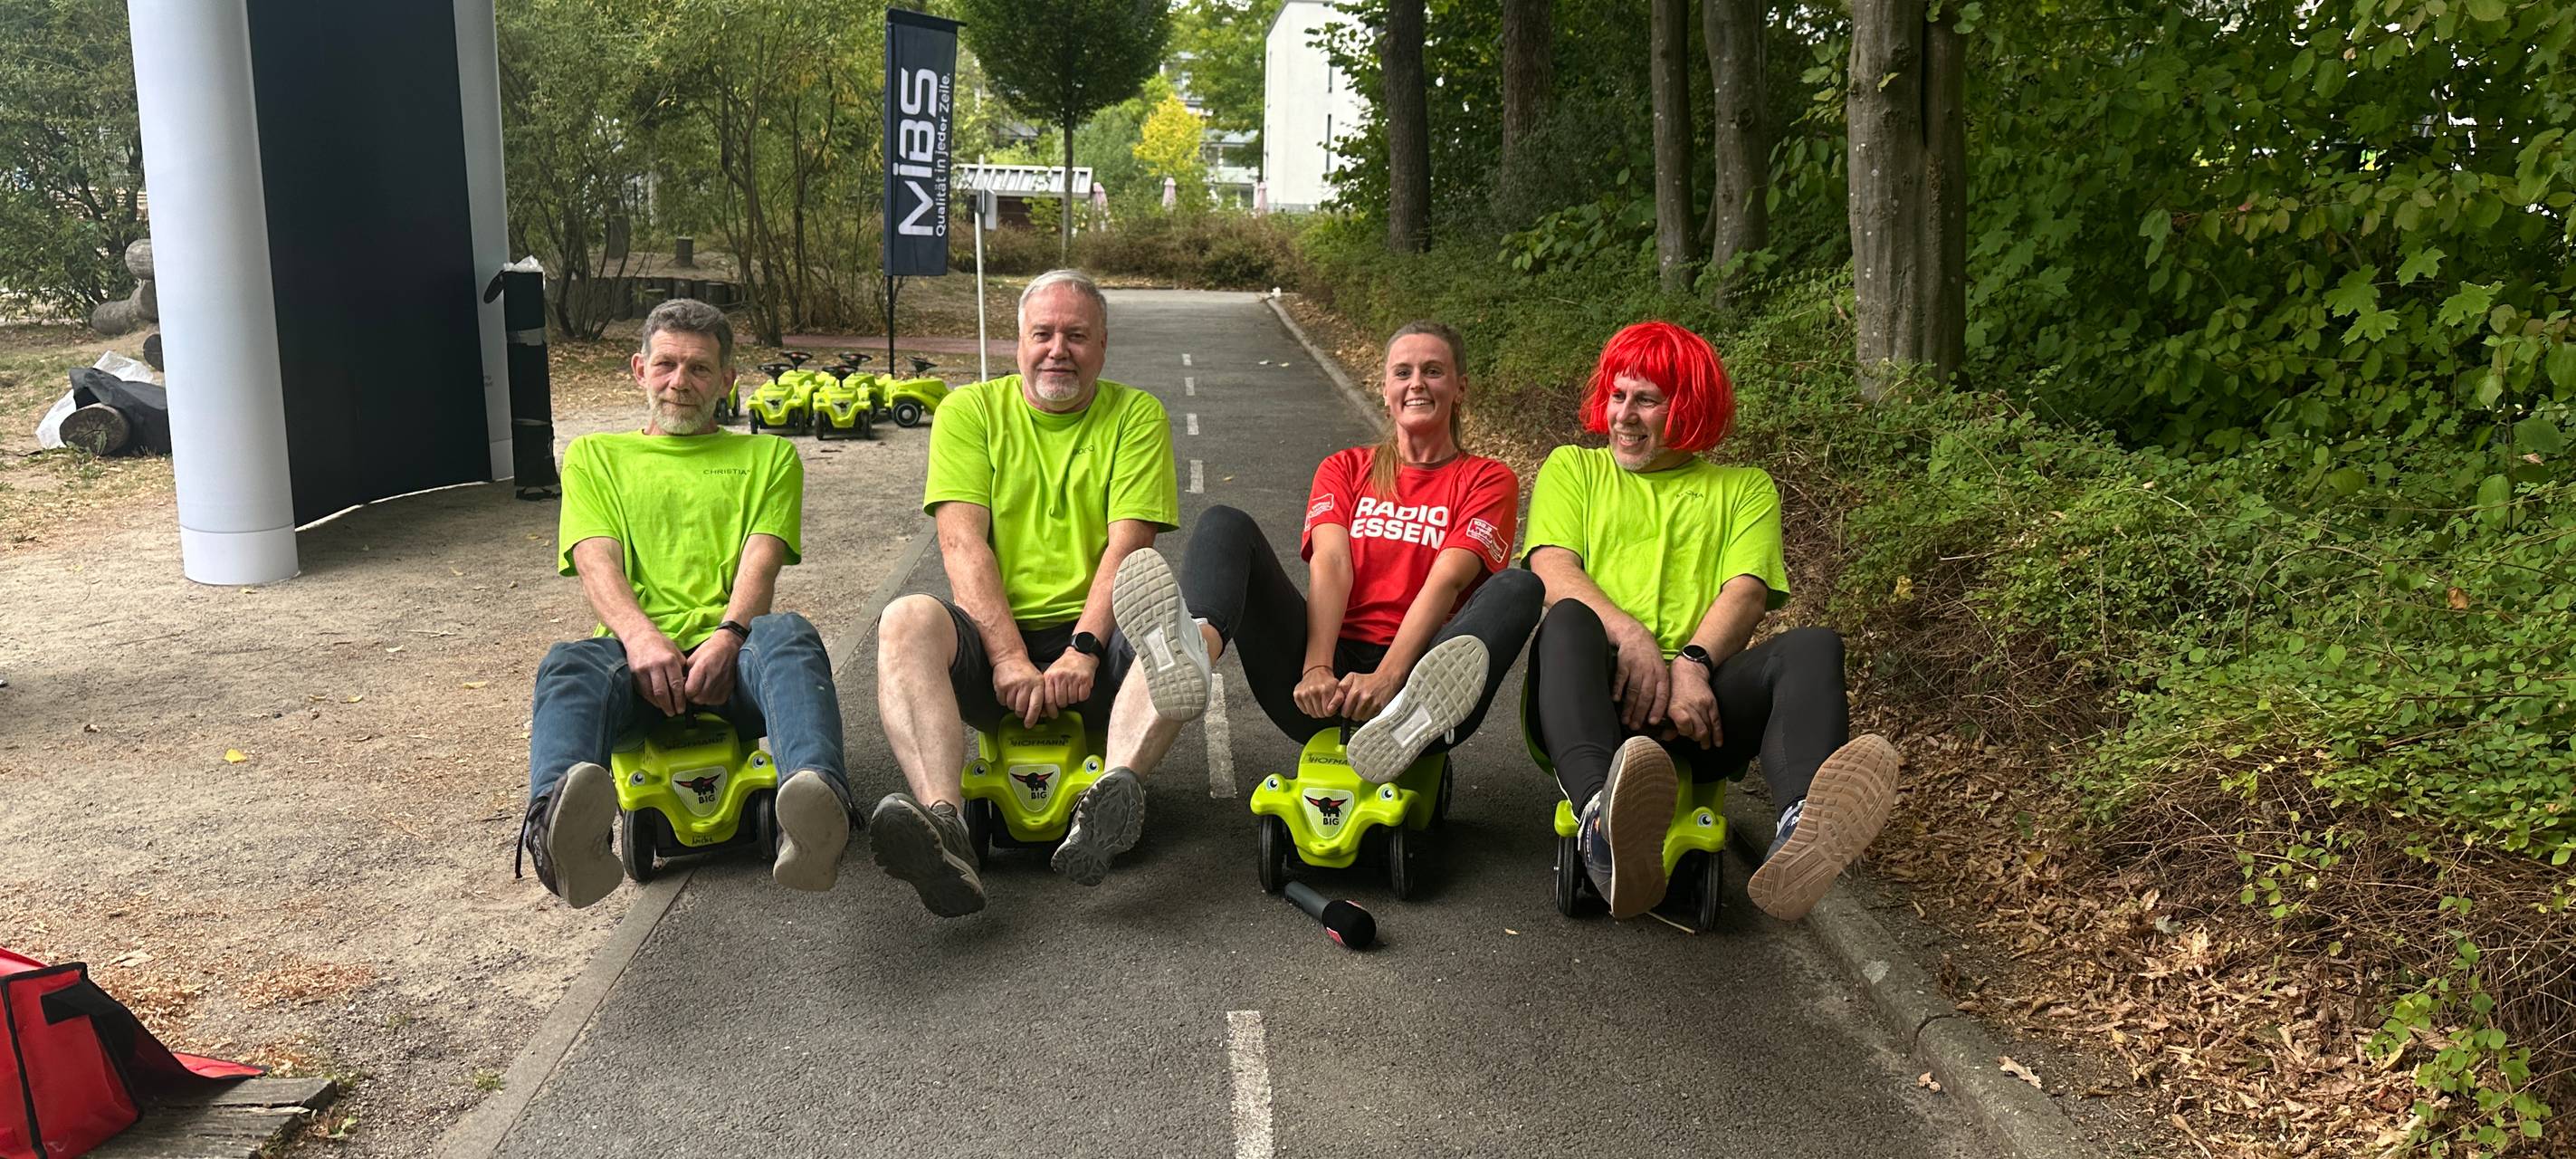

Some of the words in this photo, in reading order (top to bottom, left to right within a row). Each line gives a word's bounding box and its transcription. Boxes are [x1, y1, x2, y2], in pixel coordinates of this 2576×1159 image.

[939, 72, 950, 113] Zelle.
[935, 116, 949, 157] jeder
[934, 158, 947, 172] in
[935, 177, 947, 237] Qualität
[702, 468, 751, 476] CHRISTIA
[1355, 496, 1449, 527] RADIO
[1350, 517, 1446, 551] ESSEN
[1308, 755, 1348, 765] HOFMA
[698, 794, 716, 804] BIG
[1030, 790, 1047, 800] BIG
[1322, 817, 1340, 826] BIG
